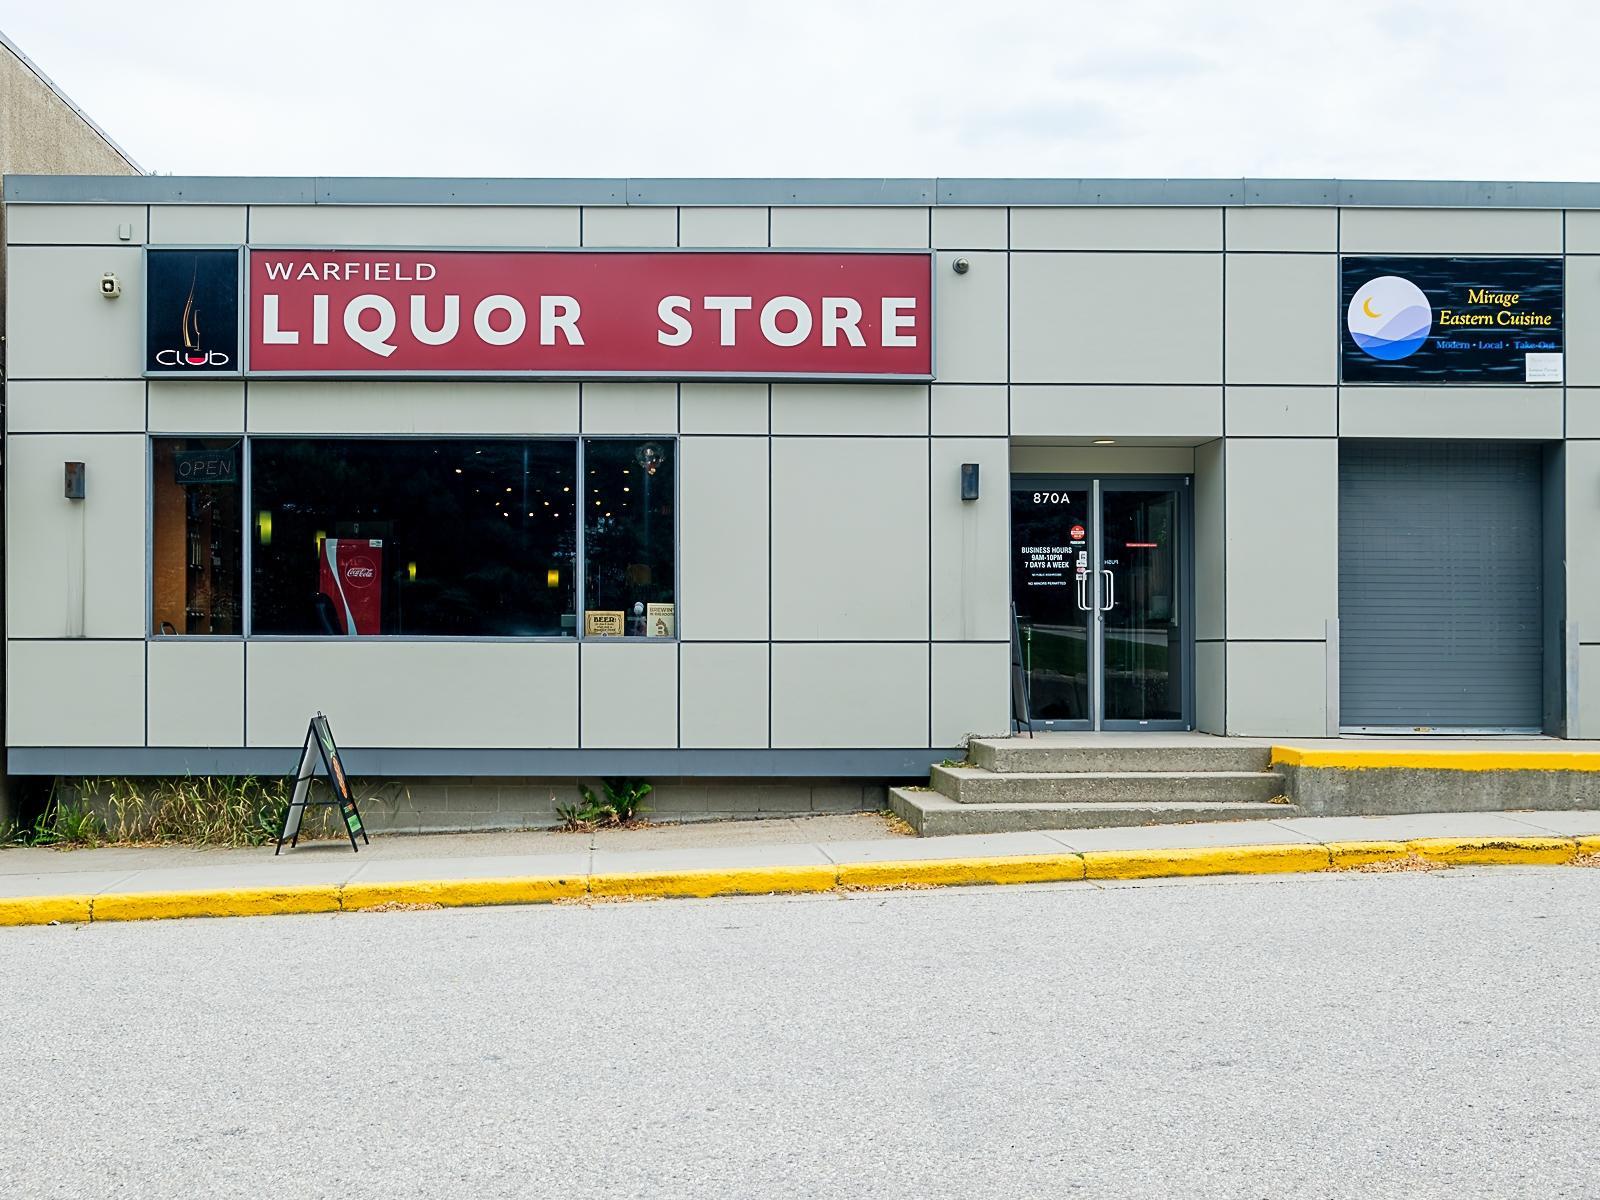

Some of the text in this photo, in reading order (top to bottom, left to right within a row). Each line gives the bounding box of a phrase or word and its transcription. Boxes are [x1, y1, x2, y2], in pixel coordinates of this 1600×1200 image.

[264, 262, 437, 281] WARFIELD
[1467, 288, 1520, 307] Mirage
[1439, 310, 1552, 325] Eastern Cuisine
[262, 294, 917, 358] LIQUOR STORE
[1436, 340, 1556, 350] Modern Local Take-Out
[179, 460, 231, 476] OPEN
[1033, 492, 1071, 504] 870A
[1021, 546, 1073, 554] BUSINESS HOURS
